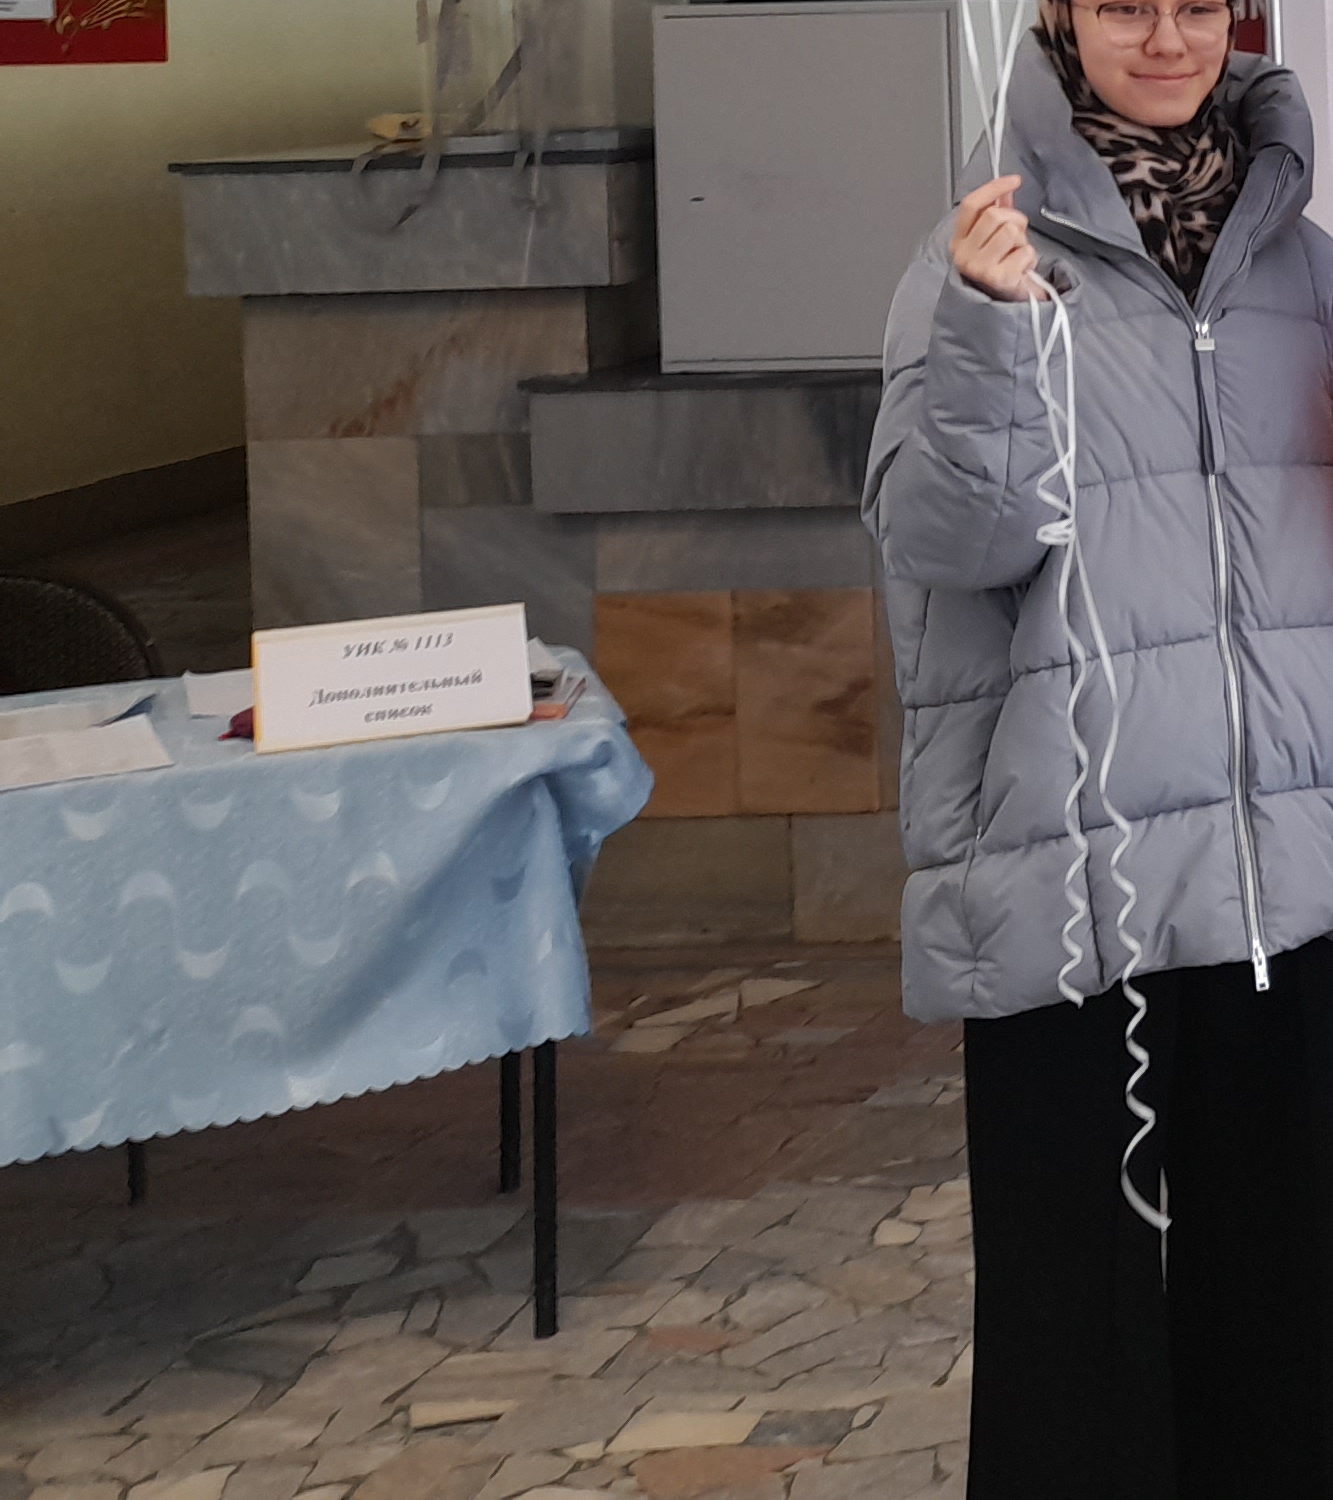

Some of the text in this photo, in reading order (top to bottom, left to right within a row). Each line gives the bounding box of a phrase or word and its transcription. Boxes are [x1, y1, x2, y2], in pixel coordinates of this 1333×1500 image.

[343, 639, 387, 660] УИК
[414, 632, 454, 651] 1113
[308, 668, 484, 708] Дополнительный
[364, 703, 434, 723] список
